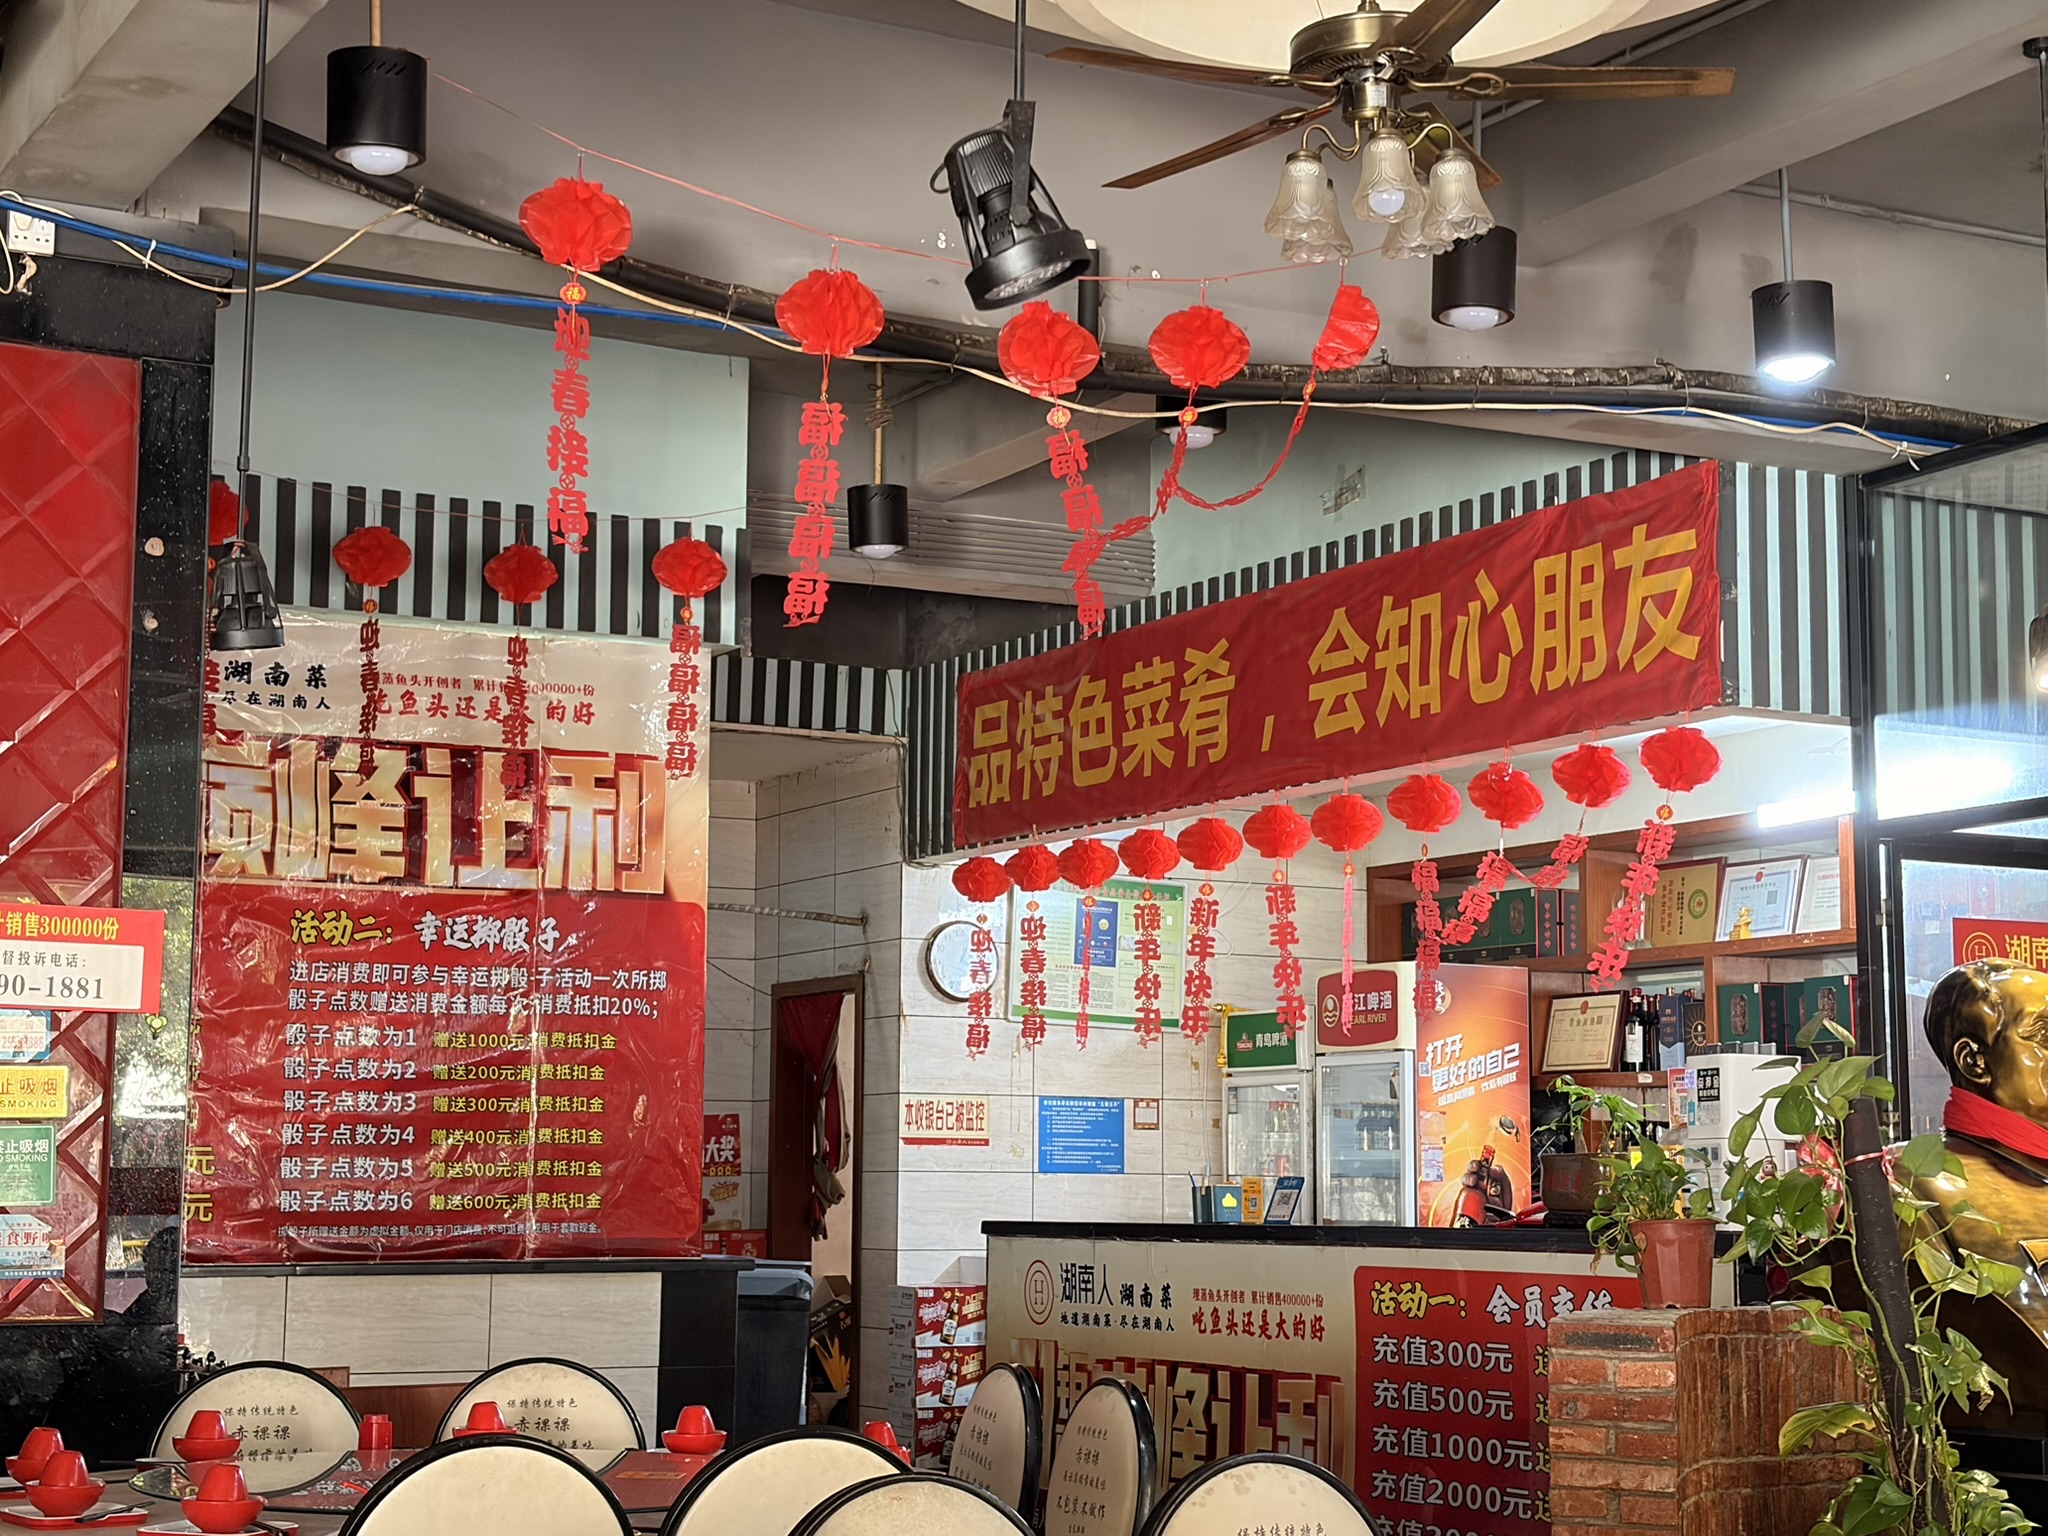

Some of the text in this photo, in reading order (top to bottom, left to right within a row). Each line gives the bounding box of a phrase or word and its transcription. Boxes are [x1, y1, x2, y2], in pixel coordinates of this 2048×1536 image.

[224, 660, 328, 690] 湖南菜
[221, 691, 331, 711] 尽在湖南人
[0, 911, 119, 940] 销售300000份
[413, 910, 561, 953] 幸运掷骰子
[1180, 898, 1219, 1034] 新年快乐
[1368, 1012, 1387, 1023] RIVER
[285, 1023, 416, 1048] 骰子点数为1
[1255, 1032, 1289, 1048] 青岛啤酒
[1426, 1033, 1463, 1066] 打开
[282, 1056, 606, 1083] 骰子点数为2 赠送200元消费抵扣金
[1433, 1043, 1520, 1094] 更好的自己
[0, 1099, 57, 1108] SMOKING
[281, 1090, 605, 1115] 骰子点数为3 赠送300元消费抵扣金
[904, 1099, 985, 1131] 本收银台已被监控
[280, 1123, 604, 1147] 骰子点数为4 赠送400元消费抵扣金
[5, 1153, 48, 1163] SMOKING
[186, 1145, 216, 1177] 元
[279, 1155, 604, 1179] 骰子点数为5 赠送500元消费抵扣金
[184, 1193, 214, 1223] 元
[279, 1189, 603, 1213] 骰子点数为6 赠送600元消费抵扣金
[1060, 1262, 1173, 1310] 湖南人 湖南菜
[1193, 1288, 1324, 1308] 现蒸鱼头开创者 累计销售400000+份
[1192, 1306, 1325, 1342] 吃鱼头还是大的好
[1372, 1334, 1514, 1374] 充值300元
[224, 1405, 299, 1417] 保持传统特色
[507, 1396, 578, 1409] 保持传统特色
[1372, 1379, 1514, 1421] 充值500元
[1372, 1424, 1532, 1472] 充值1000元
[1371, 1469, 1532, 1519] 充值2000元
